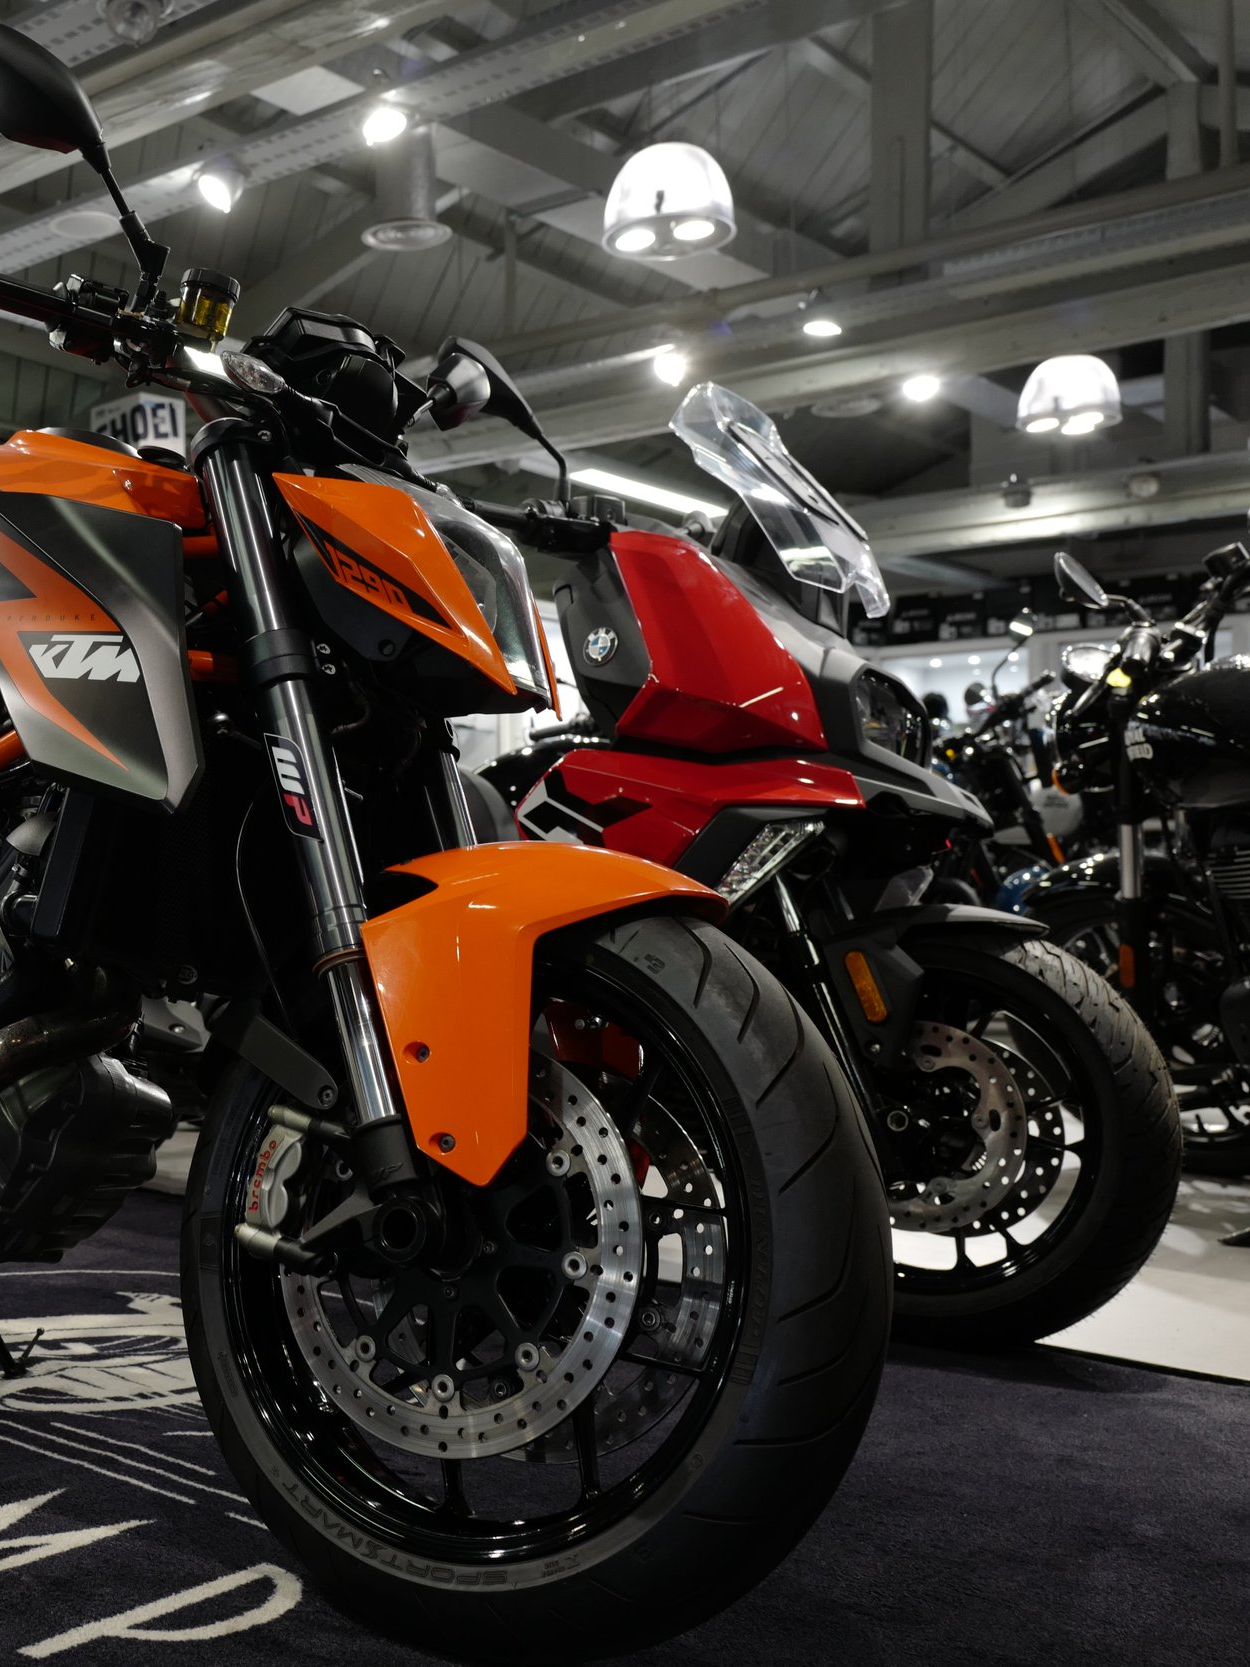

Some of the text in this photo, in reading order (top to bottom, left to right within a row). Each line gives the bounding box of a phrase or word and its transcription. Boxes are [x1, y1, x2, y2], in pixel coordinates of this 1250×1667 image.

[324, 541, 414, 613] 1290
[28, 634, 141, 683] KTM
[271, 746, 313, 826] WP
[249, 1140, 277, 1213] brembo
[281, 1483, 508, 1586] SPORTSMART
